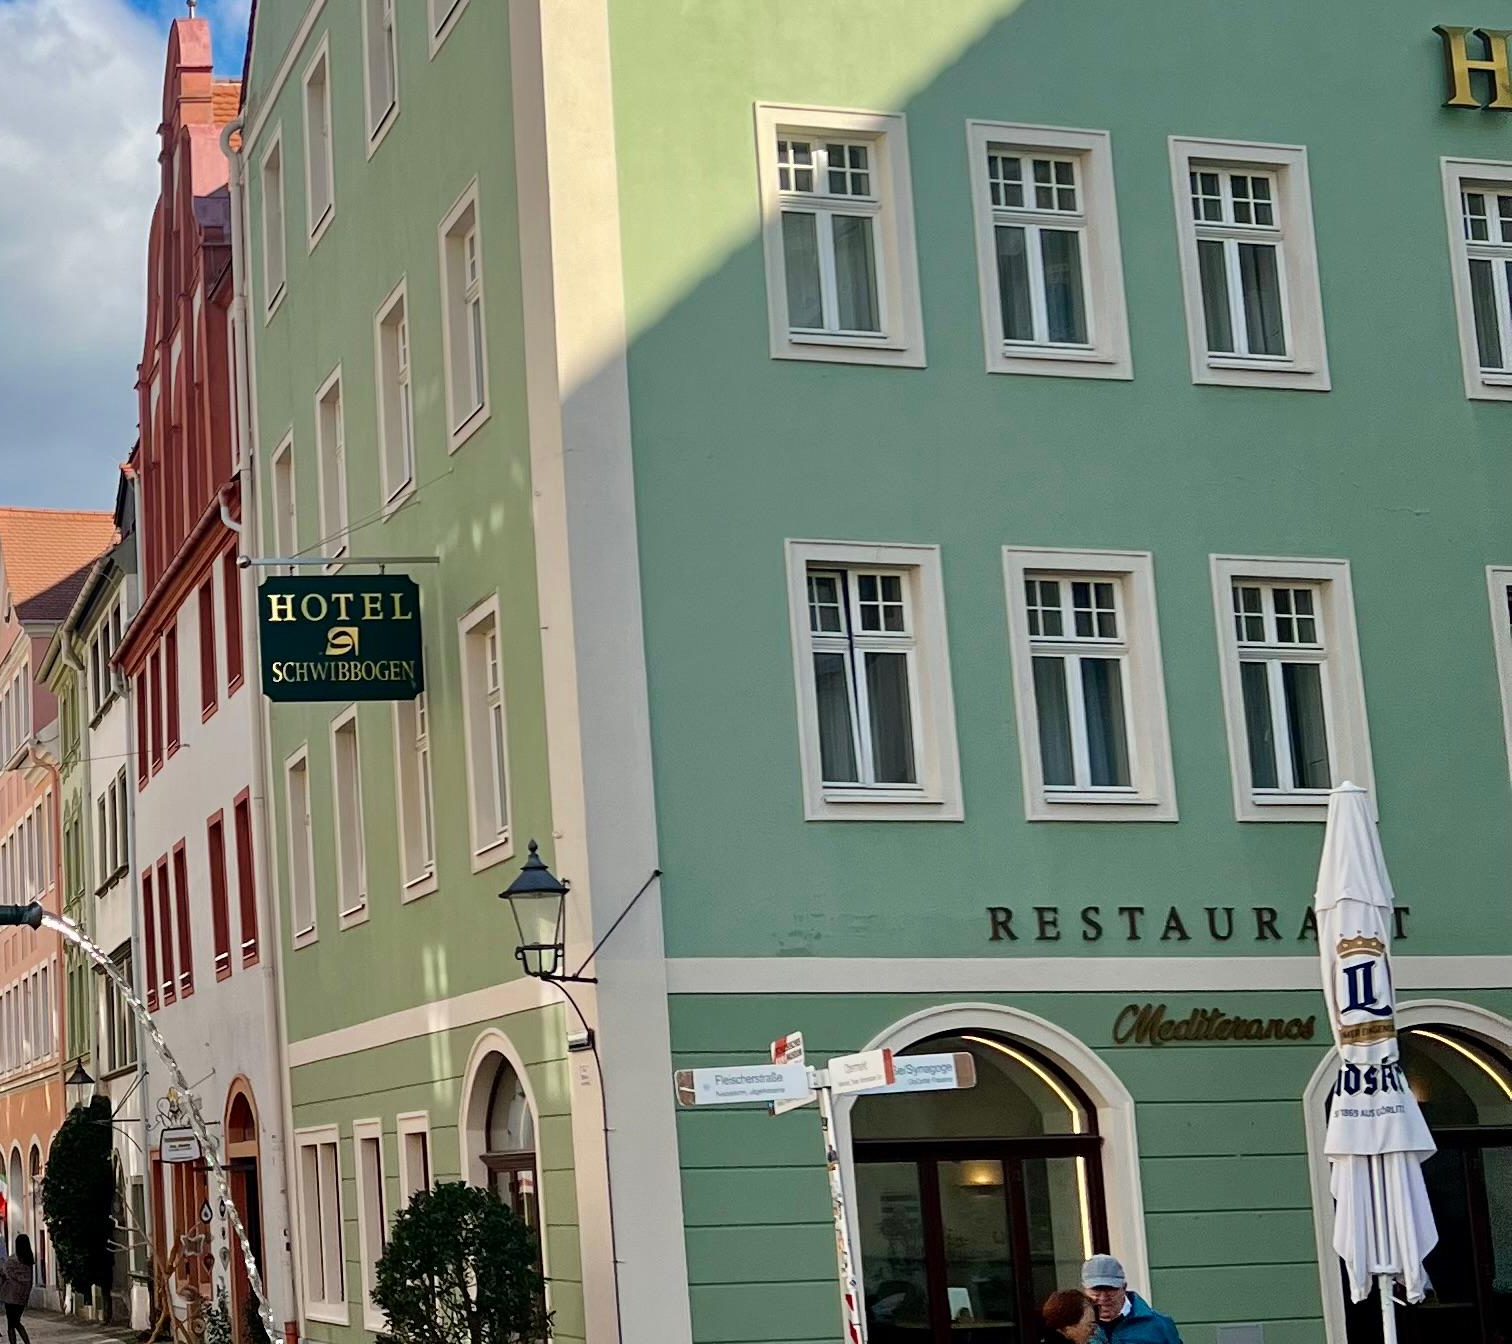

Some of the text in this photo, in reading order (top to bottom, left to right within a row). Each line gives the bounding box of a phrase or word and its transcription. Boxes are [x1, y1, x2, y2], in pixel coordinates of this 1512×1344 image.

[267, 593, 413, 622] HOTEL
[272, 660, 415, 683] SCHWIBBOGEN
[987, 906, 1410, 942] RESTAURAT
[1112, 1002, 1317, 1045] Mediteranos
[714, 1071, 784, 1086] Fleischerstraße
